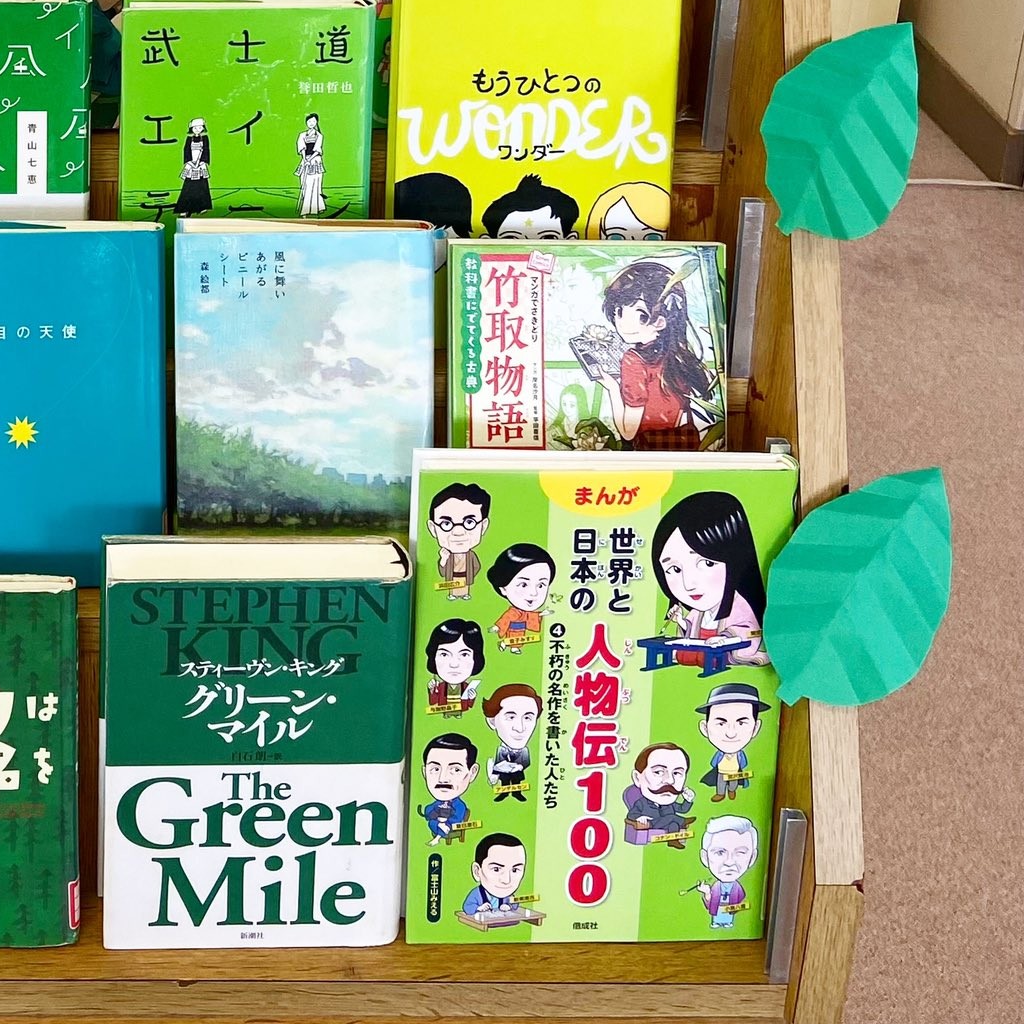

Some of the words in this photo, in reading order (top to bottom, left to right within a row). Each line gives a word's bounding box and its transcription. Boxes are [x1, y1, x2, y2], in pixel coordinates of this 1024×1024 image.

[140, 25, 354, 67] 武士道
[472, 68, 601, 97] もうひとつの
[27, 123, 38, 185] 青山七恵
[498, 144, 565, 161] ワンダー
[220, 253, 230, 288] シート
[256, 252, 267, 287] あがる
[274, 251, 286, 299] 風に舞い
[482, 264, 530, 444] 竹取物語
[574, 485, 641, 507] まんが
[569, 528, 598, 613] 日本の
[607, 527, 636, 614] 世界と
[130, 585, 395, 626] STEPHEN
[160, 625, 363, 677] KING
[177, 658, 345, 679] スティーヴン・キング
[207, 710, 314, 748] マイル
[221, 771, 292, 801] The
[116, 776, 394, 850] Green
[148, 850, 367, 927] Mile
